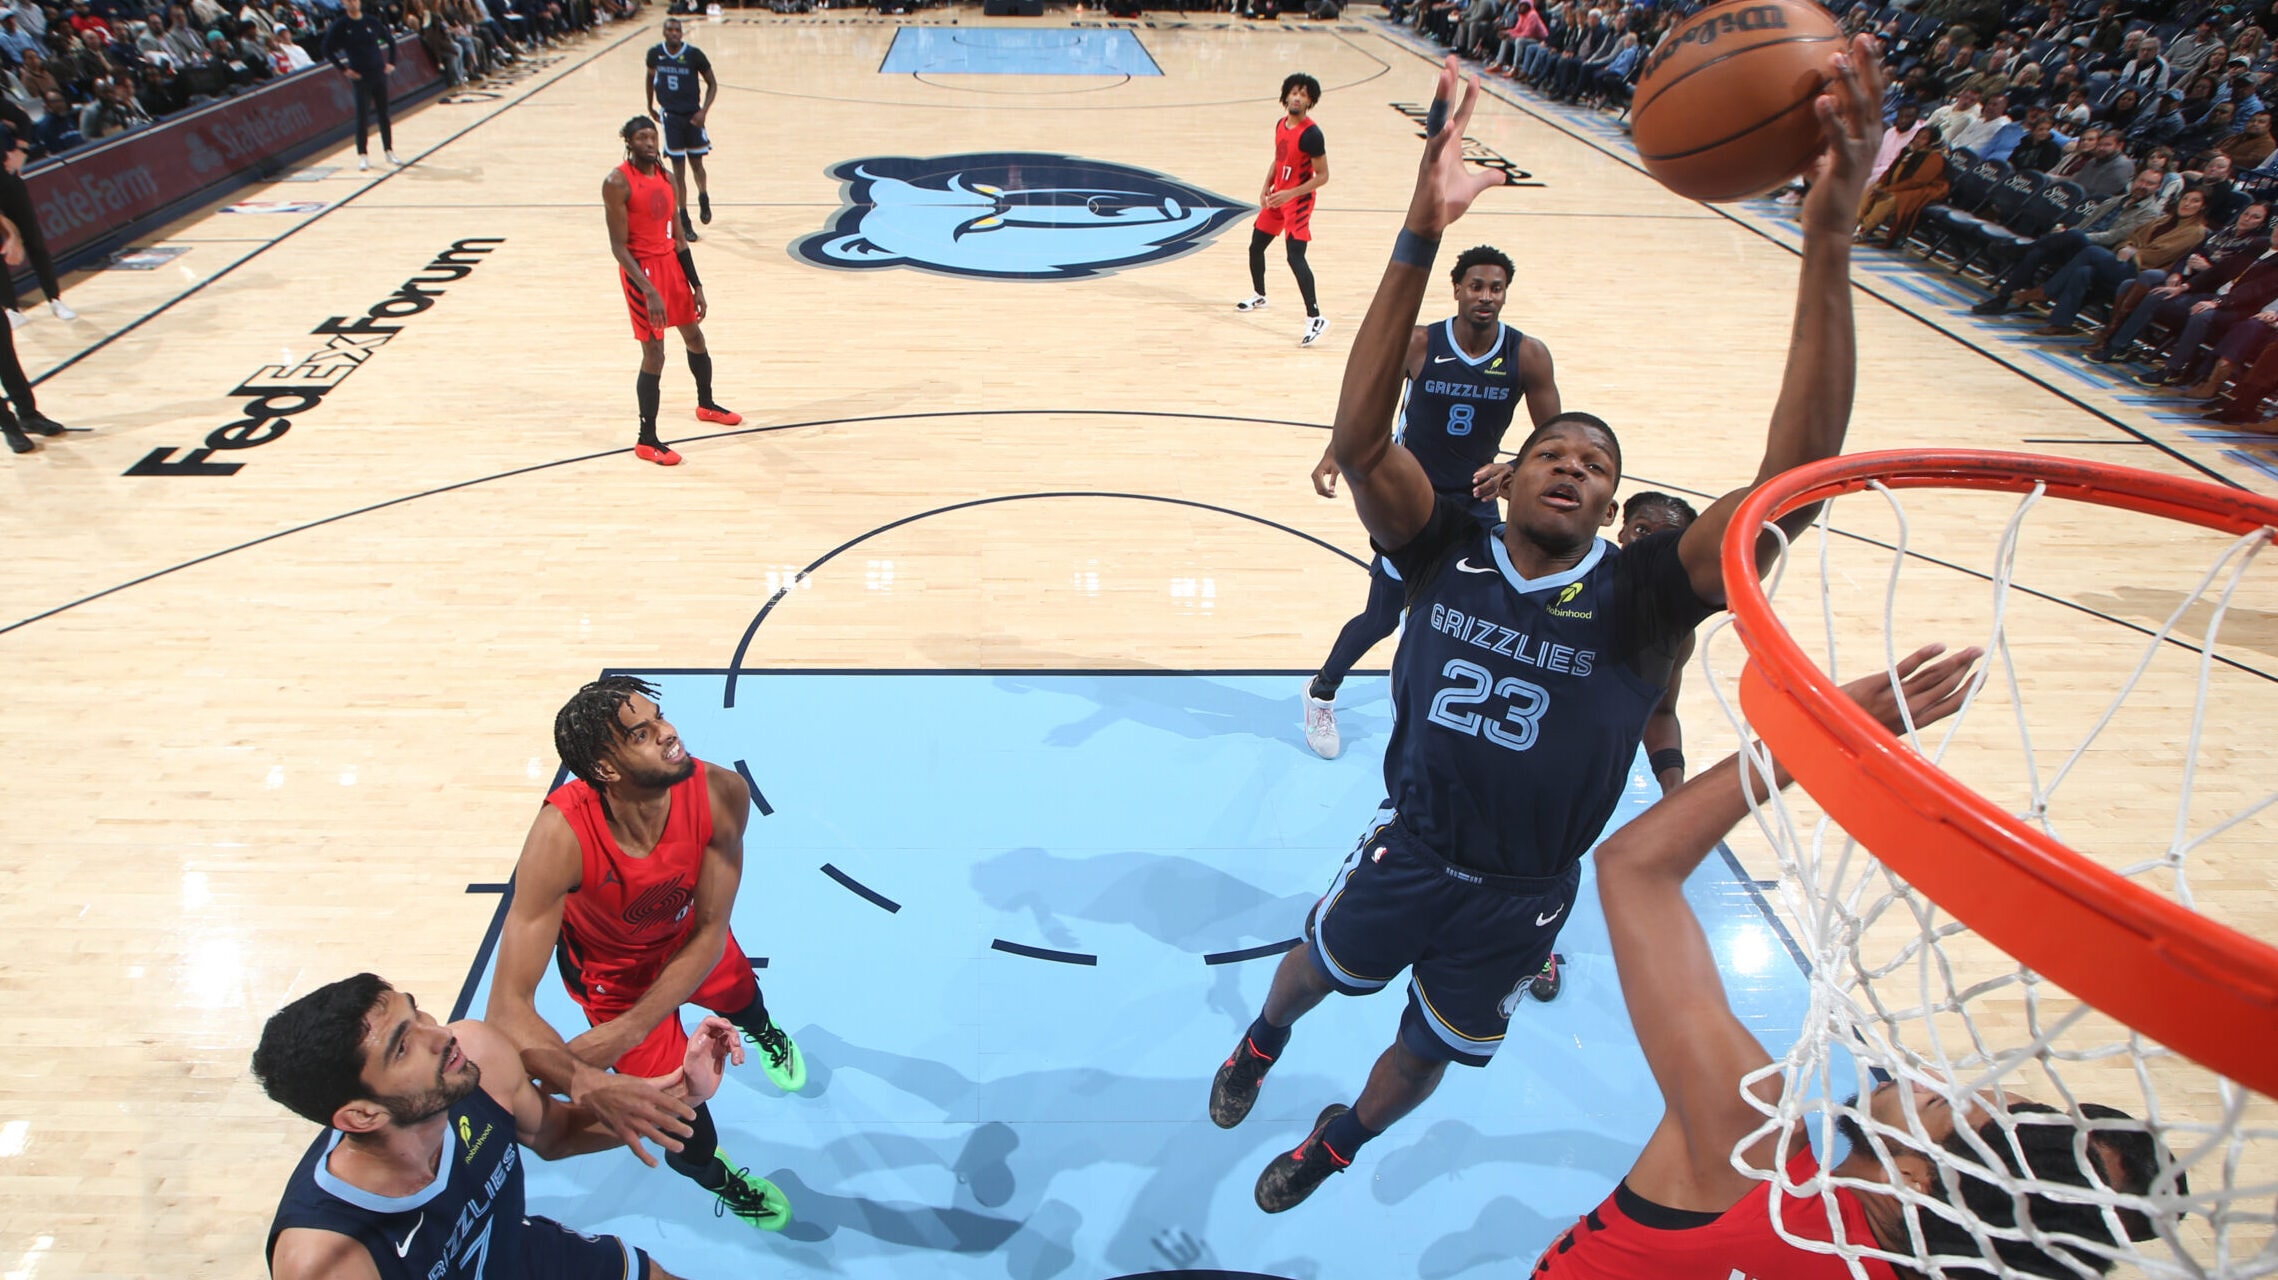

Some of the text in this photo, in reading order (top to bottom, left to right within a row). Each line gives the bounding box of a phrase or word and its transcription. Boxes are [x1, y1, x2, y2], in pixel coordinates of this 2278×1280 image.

[667, 74, 679, 91] 5
[1282, 165, 1292, 181] 17
[120, 238, 506, 476] FedExForum
[1425, 380, 1510, 400] GRIZZLIES
[1446, 403, 1475, 436] 8
[1547, 604, 1592, 620] Robinhood
[1430, 603, 1596, 677] GRIZZLIES
[1427, 658, 1550, 751] 23
[465, 1123, 493, 1165] Robinhood
